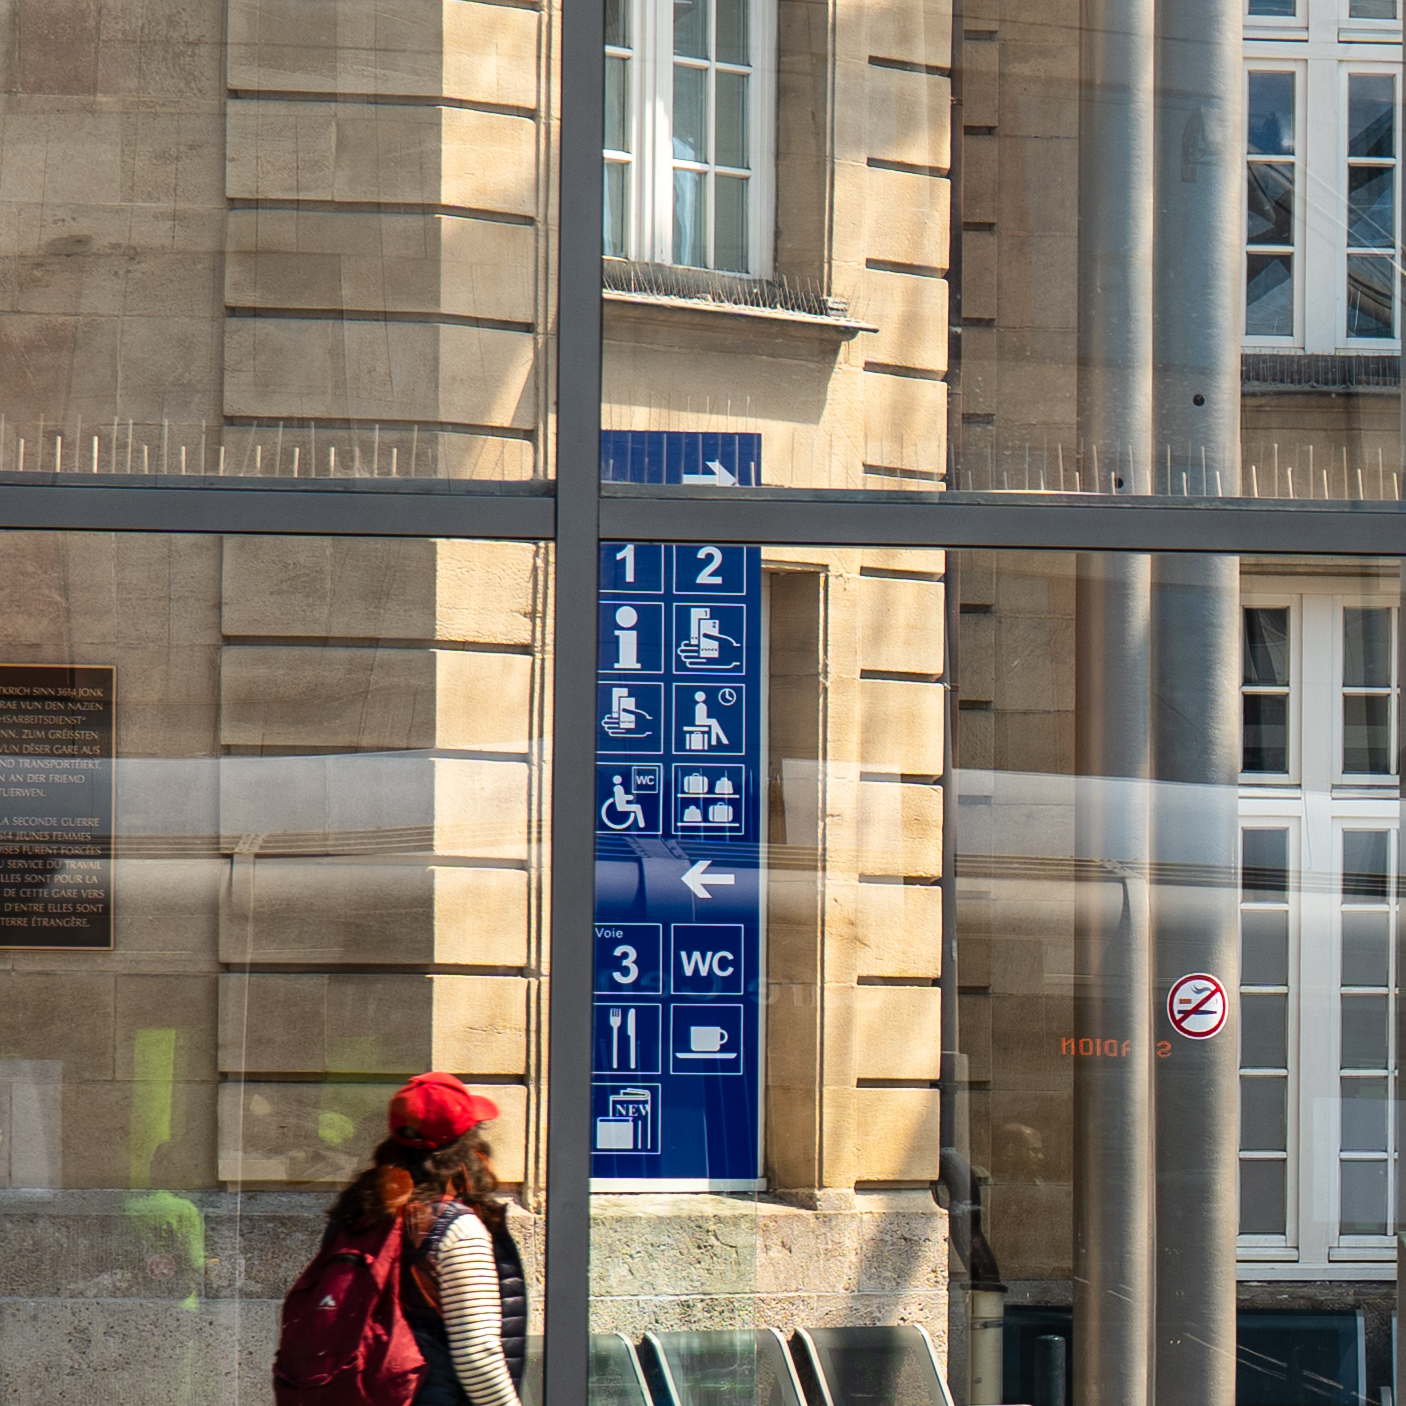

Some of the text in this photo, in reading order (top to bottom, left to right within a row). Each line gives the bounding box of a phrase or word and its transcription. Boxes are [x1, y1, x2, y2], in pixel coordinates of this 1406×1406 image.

[615, 544, 723, 583] 1 2
[32, 687, 55, 696] SINN
[78, 687, 104, 697] JONK
[20, 701, 42, 710] VUN
[45, 701, 65, 710] DEN
[67, 701, 104, 711] NAZIEN
[22, 729, 45, 739] ZUM
[53, 744, 79, 755] GARE
[81, 745, 101, 755] AUS
[9, 773, 24, 783] AN
[27, 774, 46, 783] DER
[49, 774, 86, 784] FRIEMD
[636, 775, 655, 785] WC
[12, 816, 58, 826] SECONDE
[61, 817, 100, 827] GUERRE
[16, 831, 50, 841] JEUNES
[53, 832, 92, 841] FEMMES
[22, 845, 59, 855] FURENT
[60, 844, 102, 856] FORCÉES
[7, 860, 44, 869] SERVICE
[46, 860, 62, 869] DU
[65, 861, 102, 870] TRAVAIL
[24, 874, 52, 883] SONT
[54, 874, 83, 884] POUR
[86, 875, 99, 884] LA
[4, 888, 105, 899] DE CETTE GARE VERS
[48, 903, 73, 913] ELLES
[76, 904, 104, 913] SONT
[0, 917, 29, 927] TERRE
[595, 927, 623, 939] Voie
[612, 945, 734, 984] 3 WC
